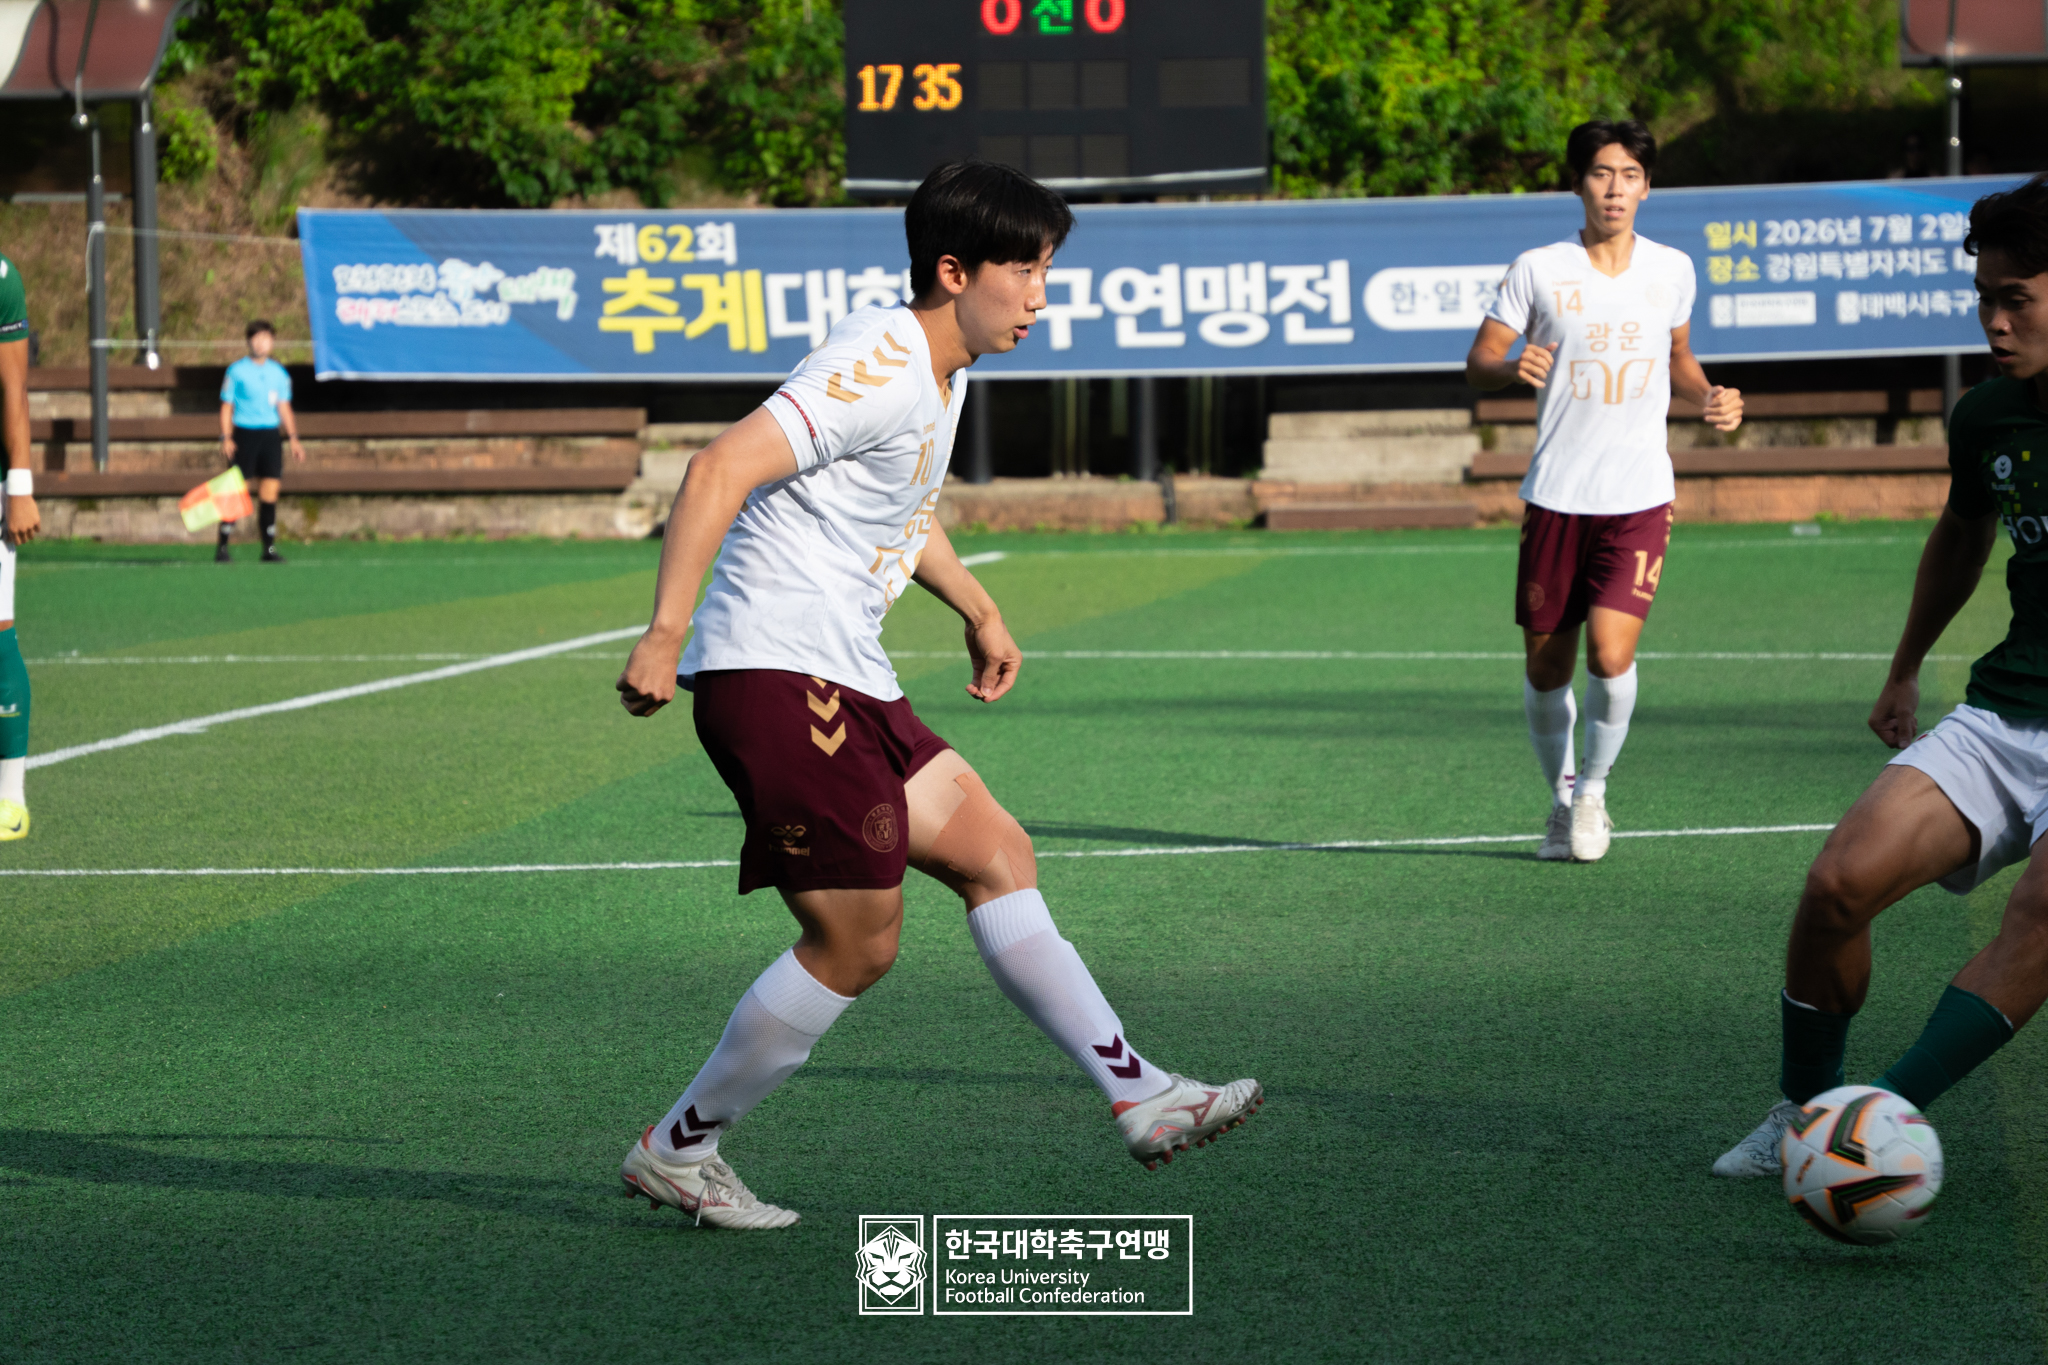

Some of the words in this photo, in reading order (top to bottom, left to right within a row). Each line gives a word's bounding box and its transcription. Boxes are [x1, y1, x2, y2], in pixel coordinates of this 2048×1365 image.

[981, 0, 1022, 35] 0
[1084, 0, 1126, 34] 0
[857, 64, 904, 111] 17
[912, 63, 963, 111] 35
[594, 222, 737, 265] 제62회
[1704, 219, 1757, 250] 일시
[1763, 215, 1862, 246] 2026년
[1868, 212, 1914, 243] 7월
[1707, 254, 1761, 285] 장소
[1552, 288, 1585, 318] 14
[1585, 321, 1643, 353] 광운
[909, 437, 935, 486] 10
[1633, 550, 1664, 592] 14
[768, 843, 811, 857] hummel
